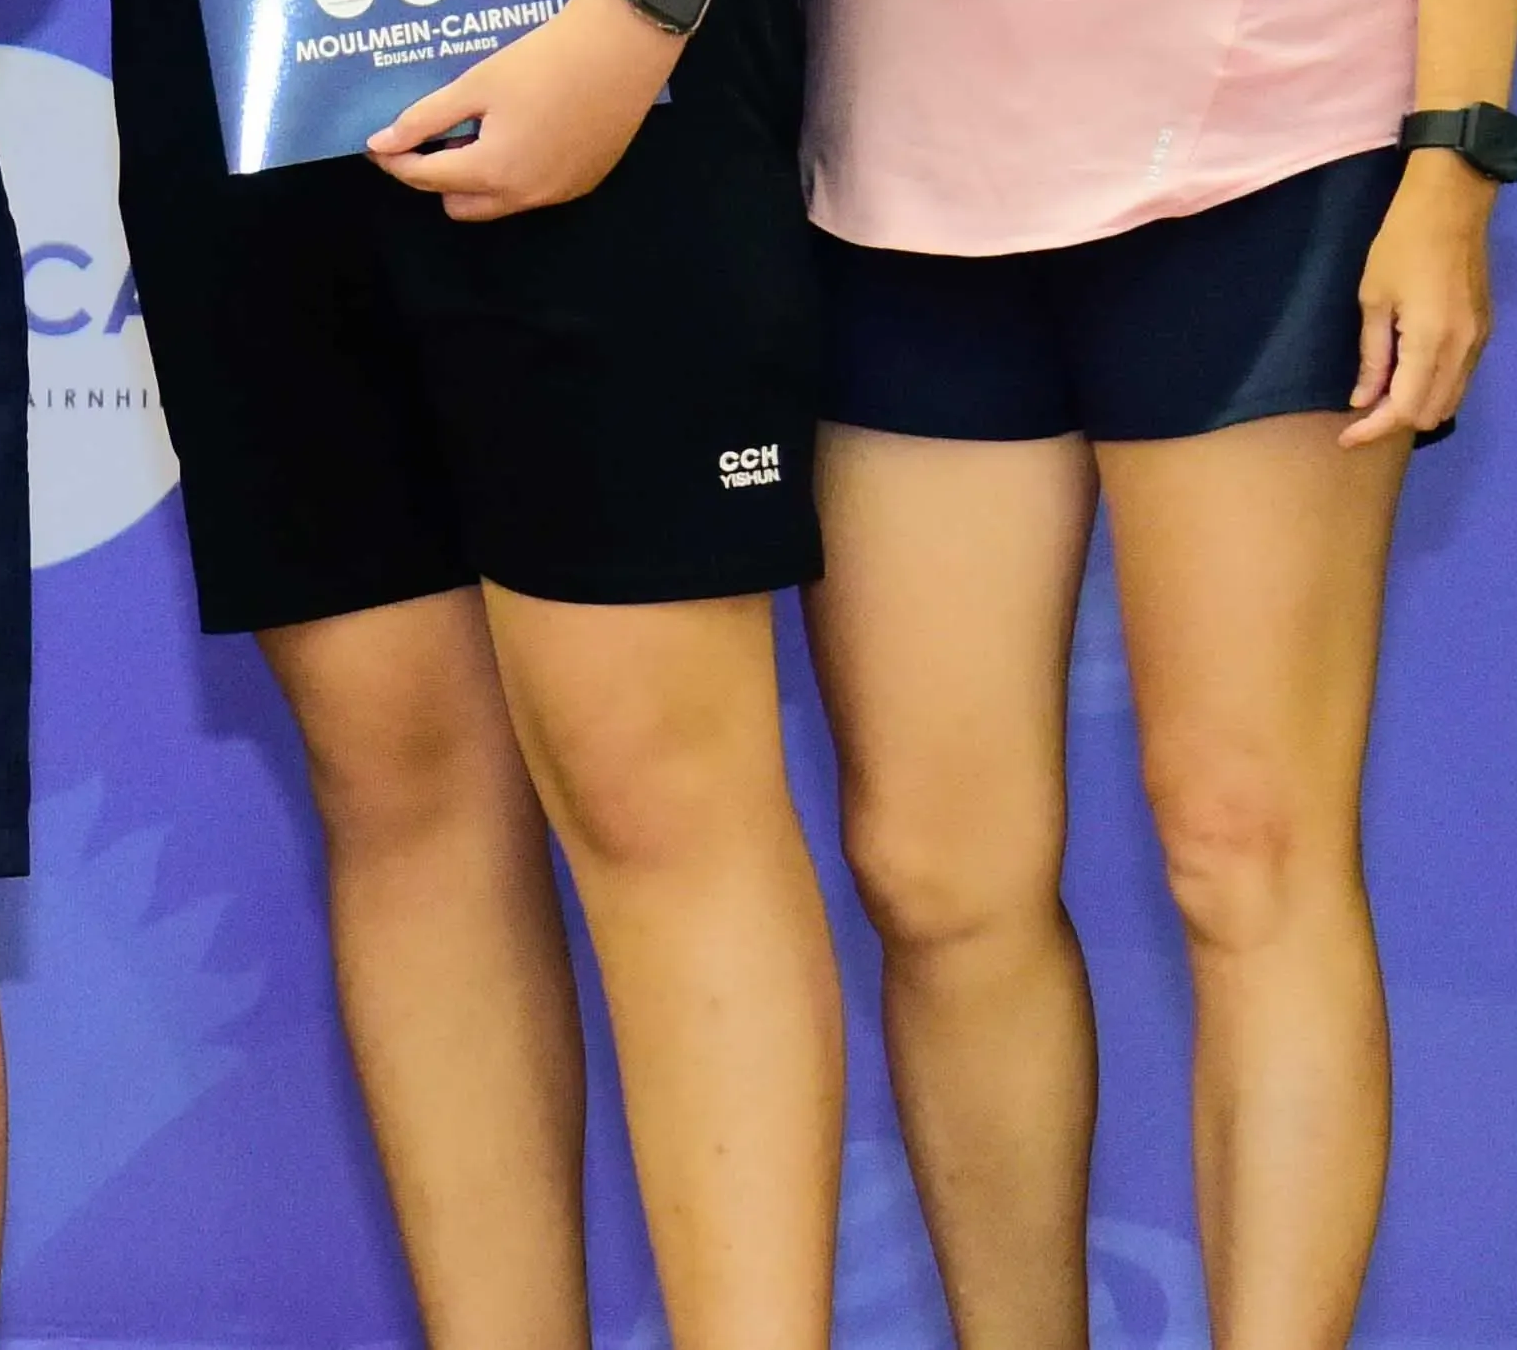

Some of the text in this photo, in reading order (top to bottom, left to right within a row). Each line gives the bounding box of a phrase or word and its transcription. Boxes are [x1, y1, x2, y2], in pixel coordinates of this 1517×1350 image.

[373, 35, 499, 69] EDUSAVE AWARDS
[718, 443, 780, 473] CCH
[719, 466, 782, 490] YISHUN
